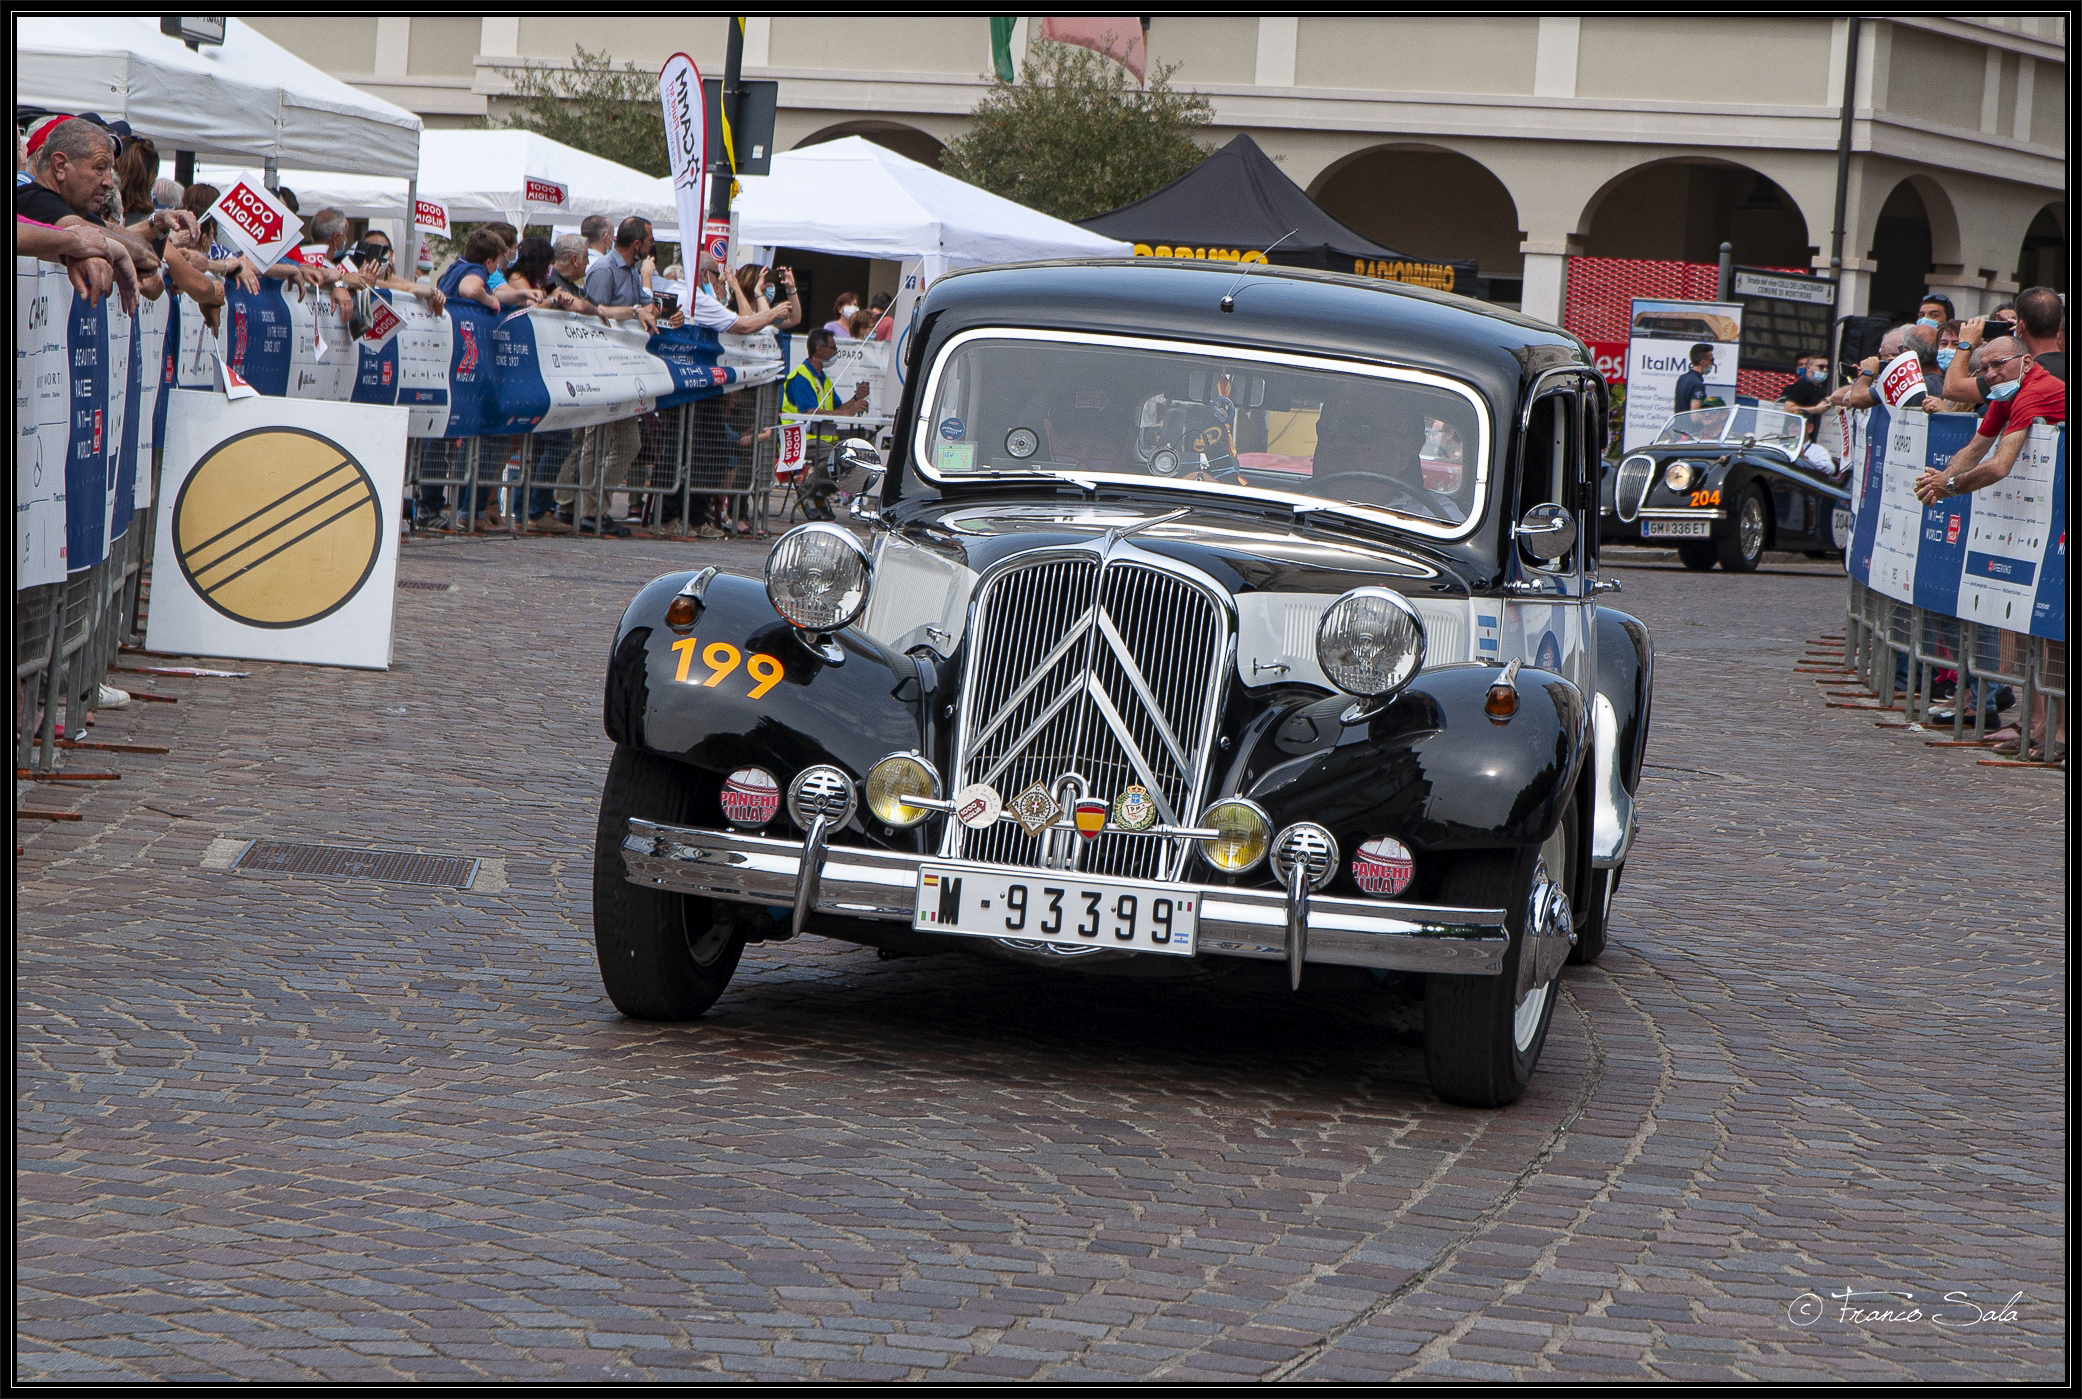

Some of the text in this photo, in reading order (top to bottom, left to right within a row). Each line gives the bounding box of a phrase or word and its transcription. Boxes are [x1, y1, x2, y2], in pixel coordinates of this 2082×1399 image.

[529, 182, 556, 195] 1000
[237, 188, 274, 224] 1000
[527, 192, 558, 204] MIGLIA
[417, 202, 441, 217] 1000
[222, 199, 265, 240] MIGLIA
[414, 214, 443, 228] MIGLIA
[1758, 286, 1778, 296] COMUNE
[375, 316, 396, 335] 1000
[1885, 361, 1918, 389] 1000
[1891, 372, 1924, 403] MIGLIA
[784, 430, 793, 460] MIGLIA
[792, 430, 801, 457] 1000
[1689, 490, 1722, 507] 204
[1650, 521, 1708, 534] GM 336 ET
[1925, 528, 1943, 542] WORLD
[671, 637, 785, 700] 199
[959, 802, 977, 816] 1000
[963, 807, 982, 821] MIGLIA
